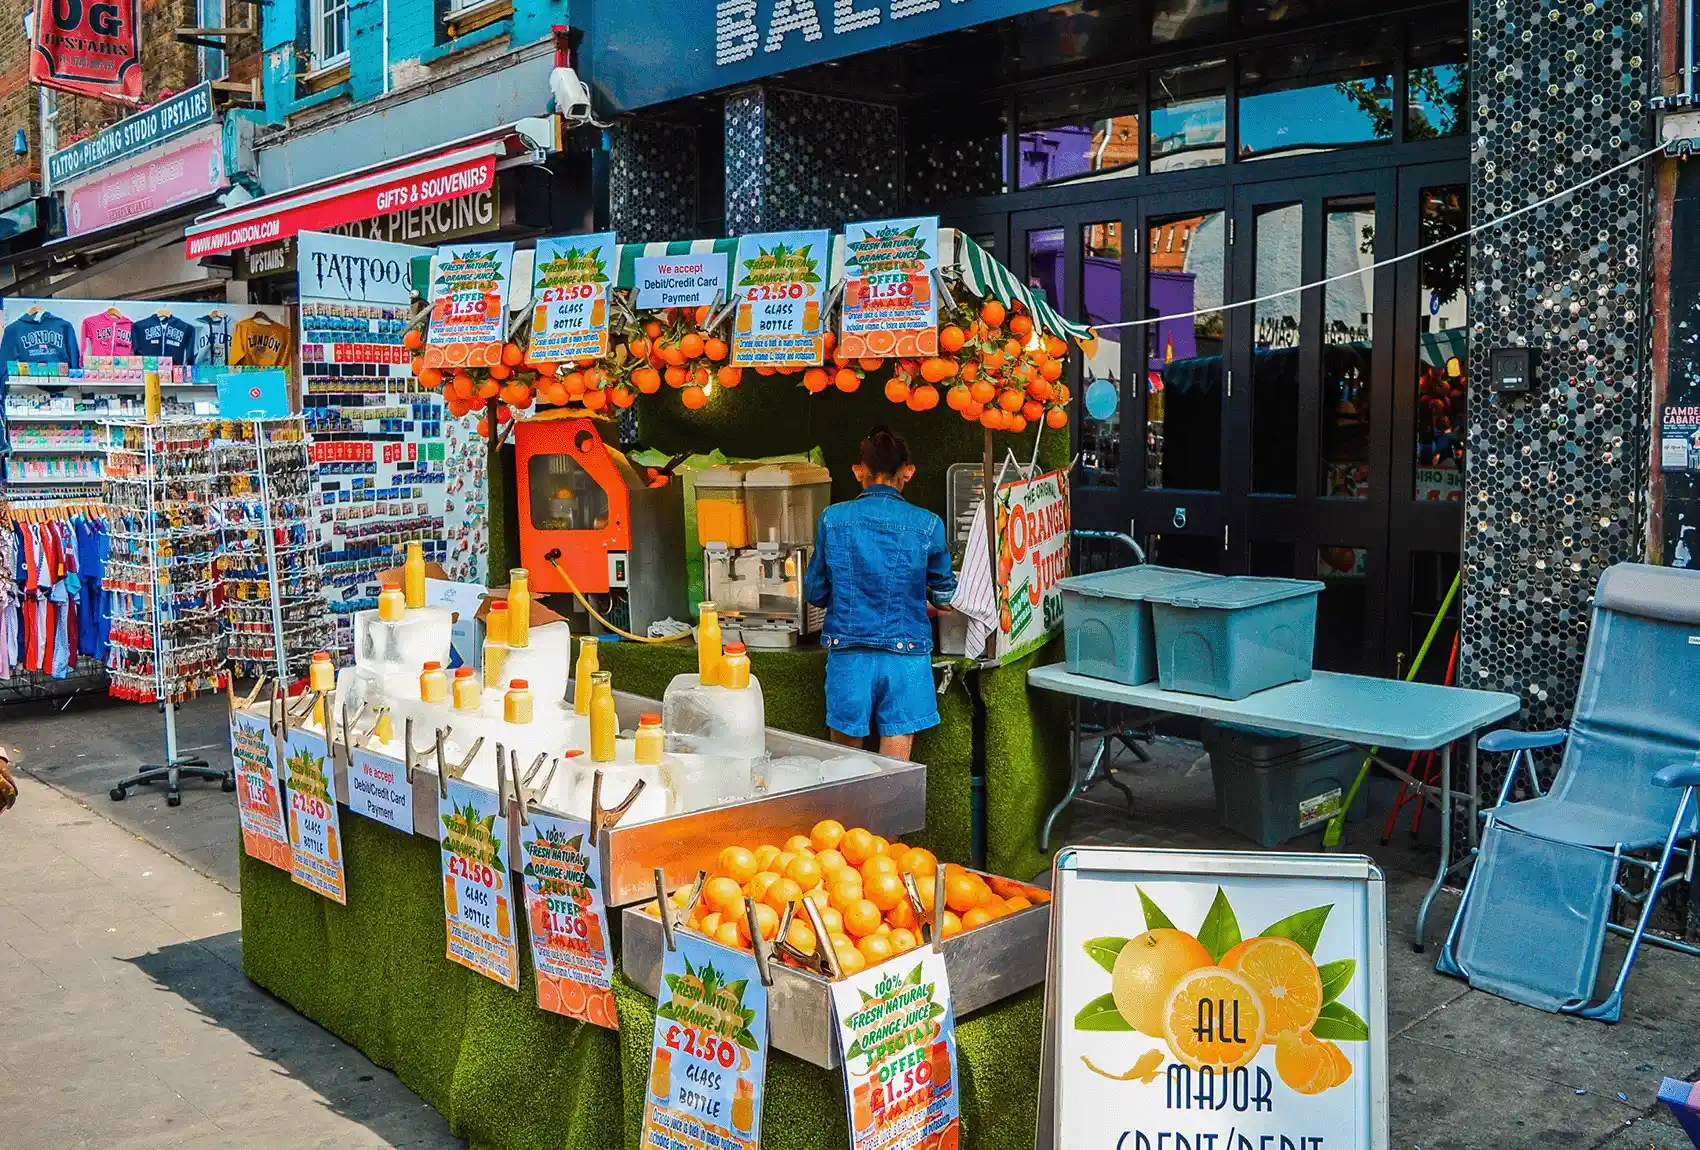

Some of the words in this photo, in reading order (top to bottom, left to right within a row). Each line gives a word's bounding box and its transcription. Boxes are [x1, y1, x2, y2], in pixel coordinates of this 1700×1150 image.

[51, 151, 79, 178] TATTOO
[83, 131, 122, 164] PIERCING
[124, 113, 157, 146] STUDIO
[160, 90, 208, 131] UPSTAIRS
[376, 188, 408, 210] GIFTS
[409, 184, 419, 203] &
[421, 165, 487, 200] SOUVENIRS
[388, 189, 492, 242] PIERCING
[876, 228, 900, 238] 100%
[854, 242, 880, 251] FRESH
[881, 238, 918, 248] NATURAL
[250, 248, 285, 275] UPSTAIRS
[443, 263, 464, 272] FRESH
[465, 261, 496, 270] NATURAL
[859, 253, 892, 262] ORANGE
[893, 250, 918, 260] JUICE
[860, 260, 918, 272] SPECIAL
[446, 274, 472, 282] ORANGE
[473, 272, 496, 280] JUICE
[658, 264, 672, 274] We
[674, 263, 703, 276] accept
[867, 273, 909, 285] OFFER
[543, 284, 593, 302] £2.50
[644, 277, 695, 290] Debit/Credit
[697, 276, 718, 288] Card
[747, 283, 803, 301] £2.50
[858, 282, 913, 299] £1.50
[443, 300, 488, 315] £1.50
[452, 293, 485, 303] OFFER
[558, 303, 583, 314] GLASS
[662, 292, 700, 304] Payment
[765, 304, 793, 315] GLASS
[553, 317, 583, 330] BOTTLE
[760, 319, 793, 330] BOTTLE
[21, 330, 64, 350] LONDON
[248, 334, 280, 353] LONDON
[1024, 487, 1036, 512] THE
[1010, 500, 1064, 562] ORANGE
[362, 762, 373, 777] We
[374, 767, 394, 786] accept
[354, 777, 389, 802] Debit/Credit
[390, 791, 406, 807] Card
[293, 792, 325, 819] £2.50
[367, 800, 394, 821] Payment
[304, 818, 321, 836] GLASS
[545, 829, 566, 845] 100%
[303, 835, 324, 855] BOTTLE
[528, 845, 551, 860] FRESH
[552, 849, 585, 866] NATURAL
[449, 856, 494, 888] £2.50
[534, 863, 564, 880] ORANGE
[565, 868, 584, 884] JUICE
[465, 886, 488, 906] GLASS
[537, 877, 587, 900] SPECIAL
[463, 905, 490, 929] BOTTLE
[546, 897, 580, 917] OFFER
[543, 908, 588, 937] £1.50
[874, 973, 903, 998] 100%
[673, 1004, 715, 1030] ORANGE
[852, 1003, 884, 1031] FRESH
[885, 983, 929, 1015] NATURAL
[861, 1018, 902, 1050] ORANGE
[902, 1004, 930, 1029] JUICE
[1192, 997, 1246, 1044] ALL
[666, 1024, 736, 1068] £2.50
[866, 1020, 934, 1068] SPECIAL
[878, 1047, 927, 1083] OFFER
[686, 1063, 722, 1091] GLASS
[871, 1060, 933, 1111] £1.50
[1166, 1063, 1273, 1112] MAJOR
[678, 1087, 721, 1118] BOTTLE
[876, 1085, 934, 1128] SMALL
